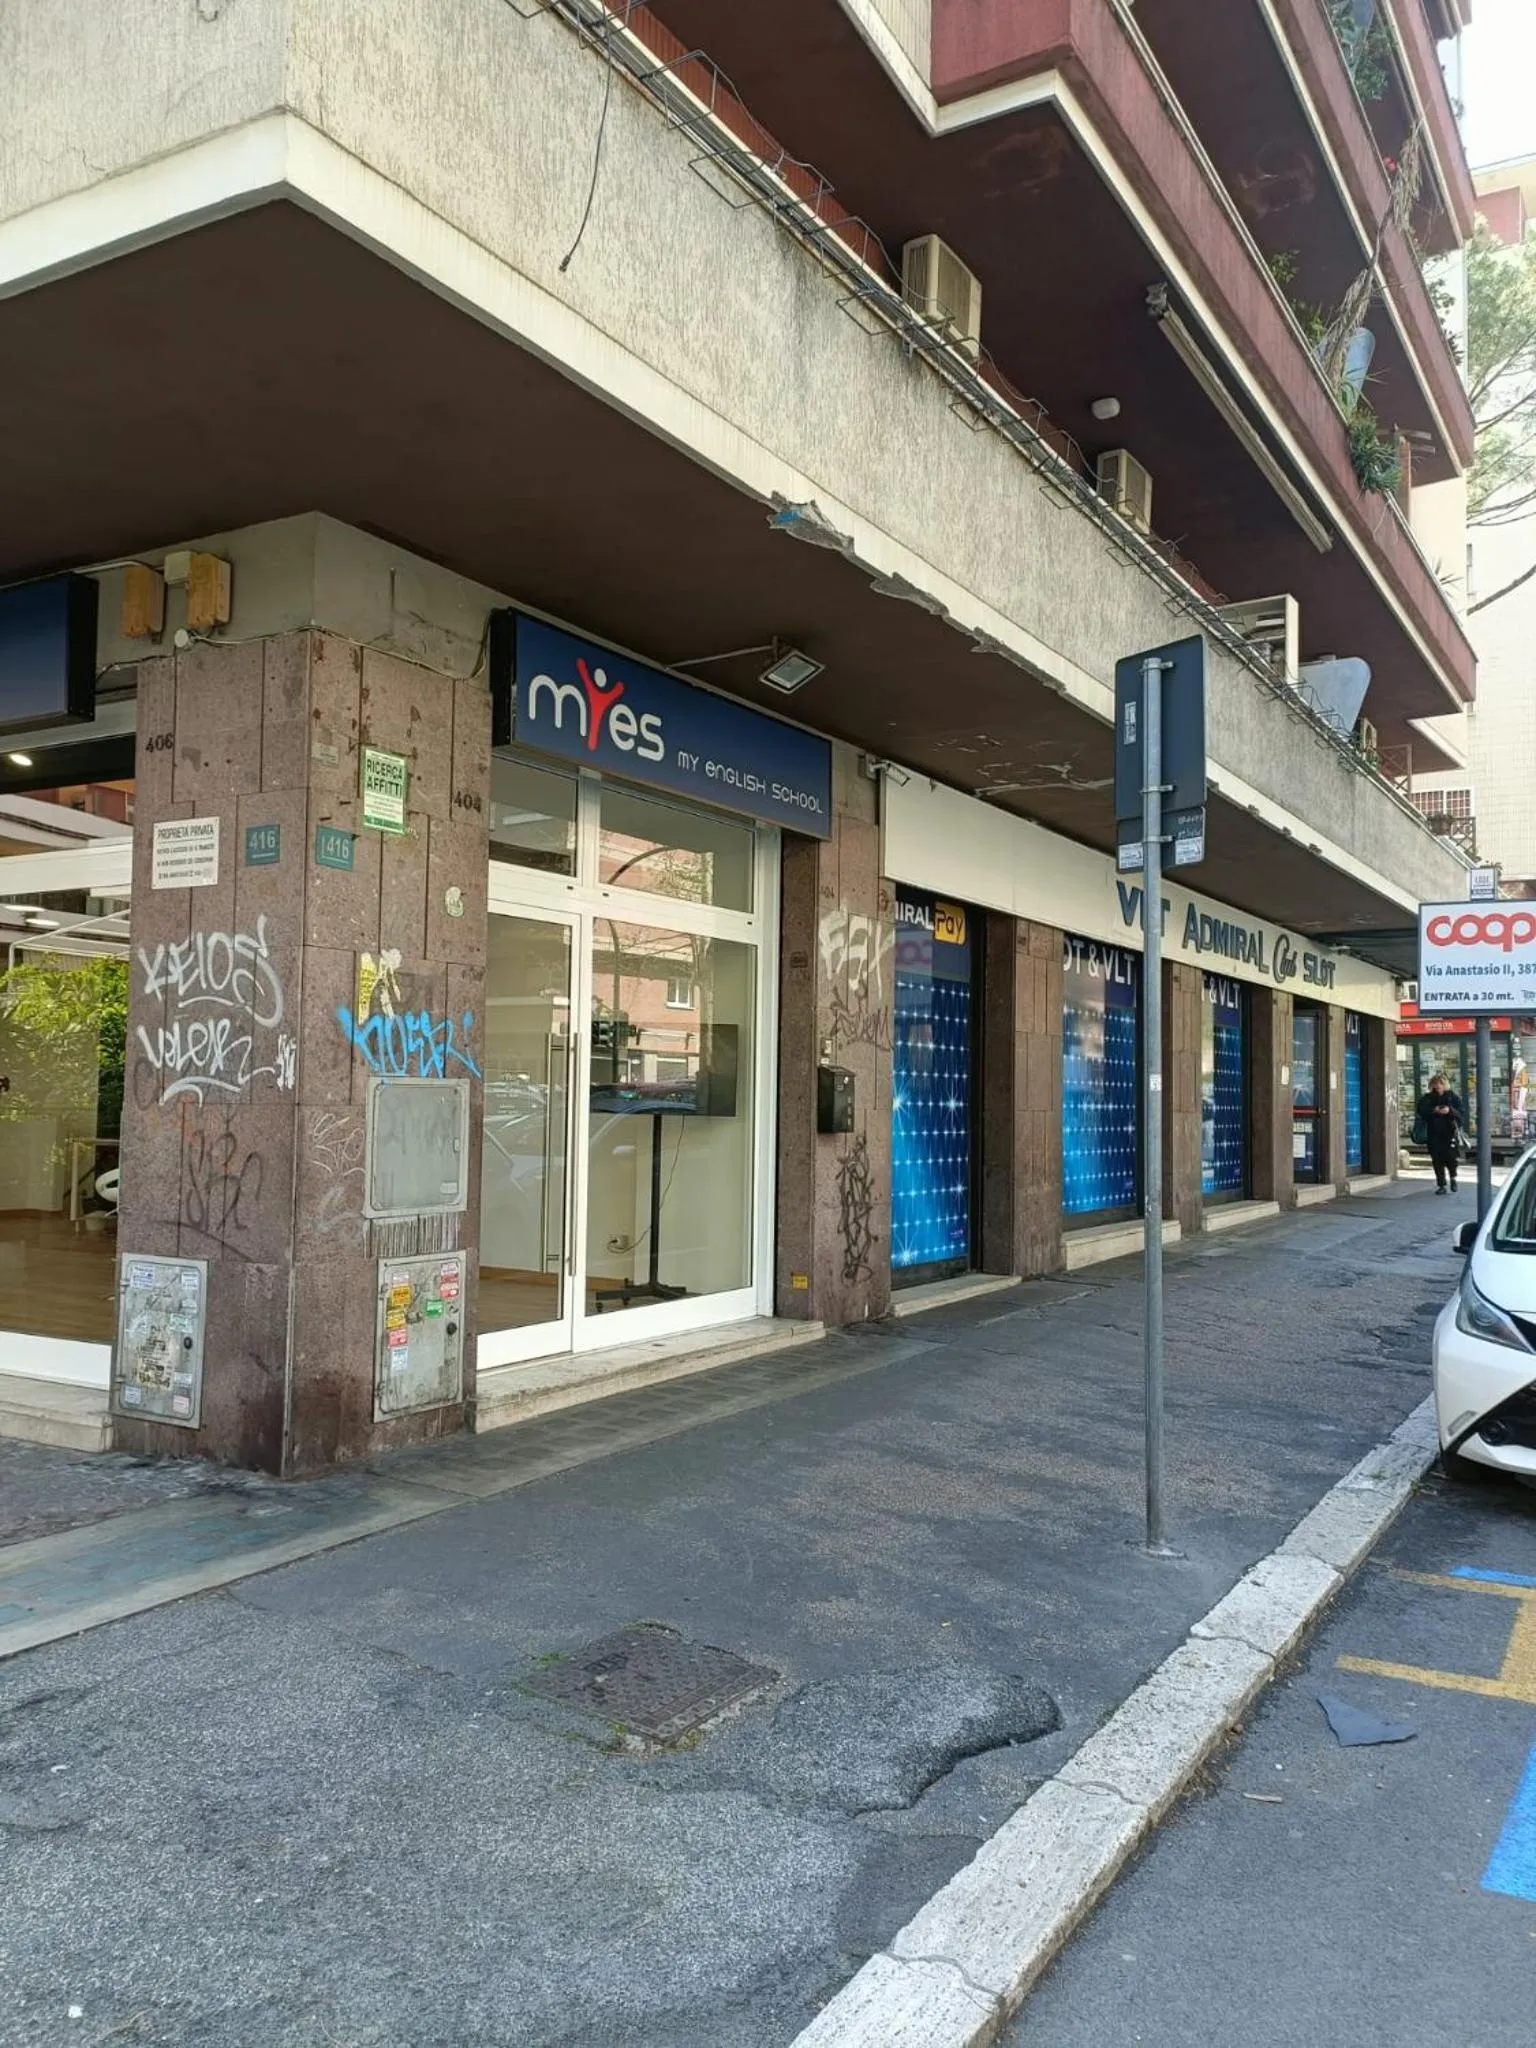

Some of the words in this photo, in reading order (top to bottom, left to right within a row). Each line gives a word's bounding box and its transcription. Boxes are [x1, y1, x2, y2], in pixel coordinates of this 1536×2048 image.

[145, 733, 174, 752] 406
[366, 758, 403, 780] RICERCA
[366, 776, 403, 799] AFFITTI
[771, 783, 824, 815] SCHOOL
[248, 830, 276, 850] 416
[326, 834, 350, 860] 416
[934, 908, 964, 942] Pay
[1426, 911, 1536, 953] coop
[1182, 902, 1270, 974] ADMIRAL
[1303, 951, 1337, 990] SLOT
[1102, 946, 1136, 986] VLT
[1425, 964, 1443, 977] Via
[1445, 962, 1500, 976] Anastasio
[1218, 977, 1241, 1009] VLT
[1424, 991, 1471, 1002] ENTRATA
[1472, 993, 1479, 1001] a
[1481, 991, 1494, 1002] 30
[1496, 991, 1515, 1002] mt.
